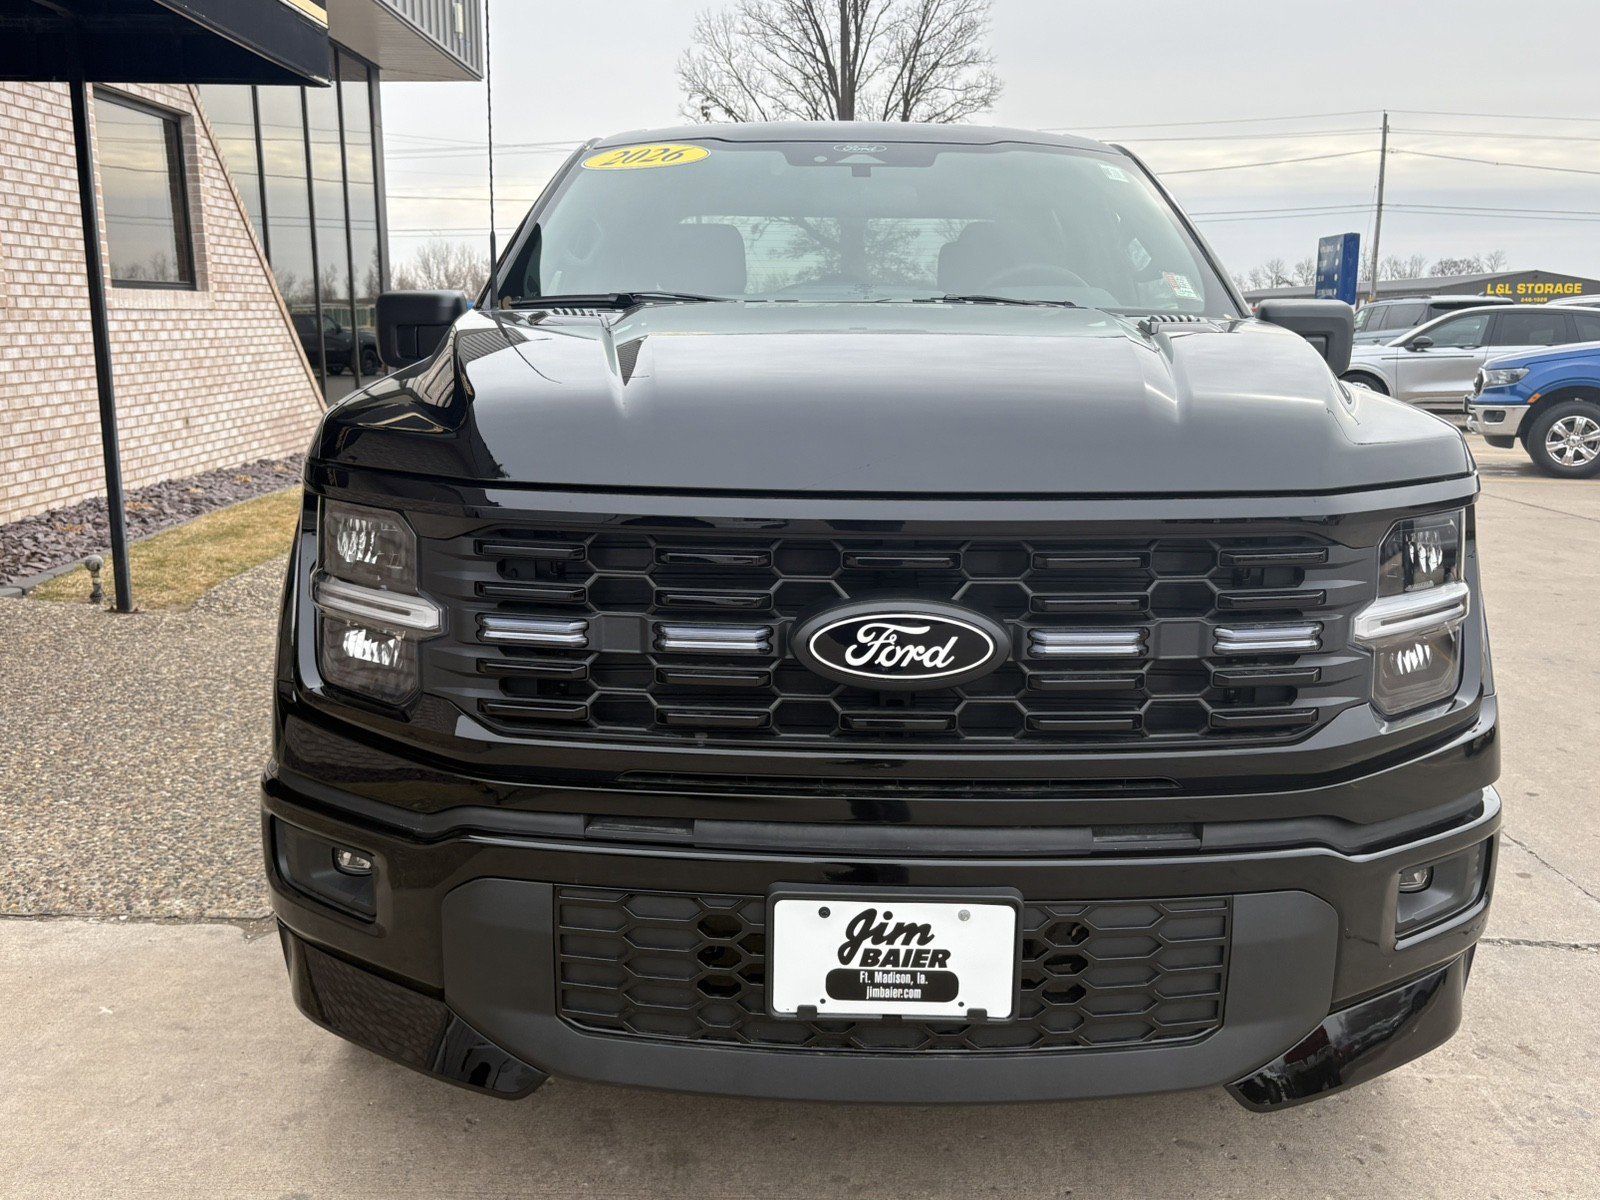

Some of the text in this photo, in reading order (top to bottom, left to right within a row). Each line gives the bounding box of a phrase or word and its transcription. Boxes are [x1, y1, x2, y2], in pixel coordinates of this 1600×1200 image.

[598, 147, 695, 167] 2026
[1486, 283, 1583, 295] L&L STORAGE
[844, 622, 959, 669] Ford
[837, 908, 935, 966] Jim
[858, 948, 952, 969] BAIER
[859, 970, 871, 984] Ft.
[874, 971, 914, 986] Madison,
[866, 985, 922, 1000] jimbaier.com
